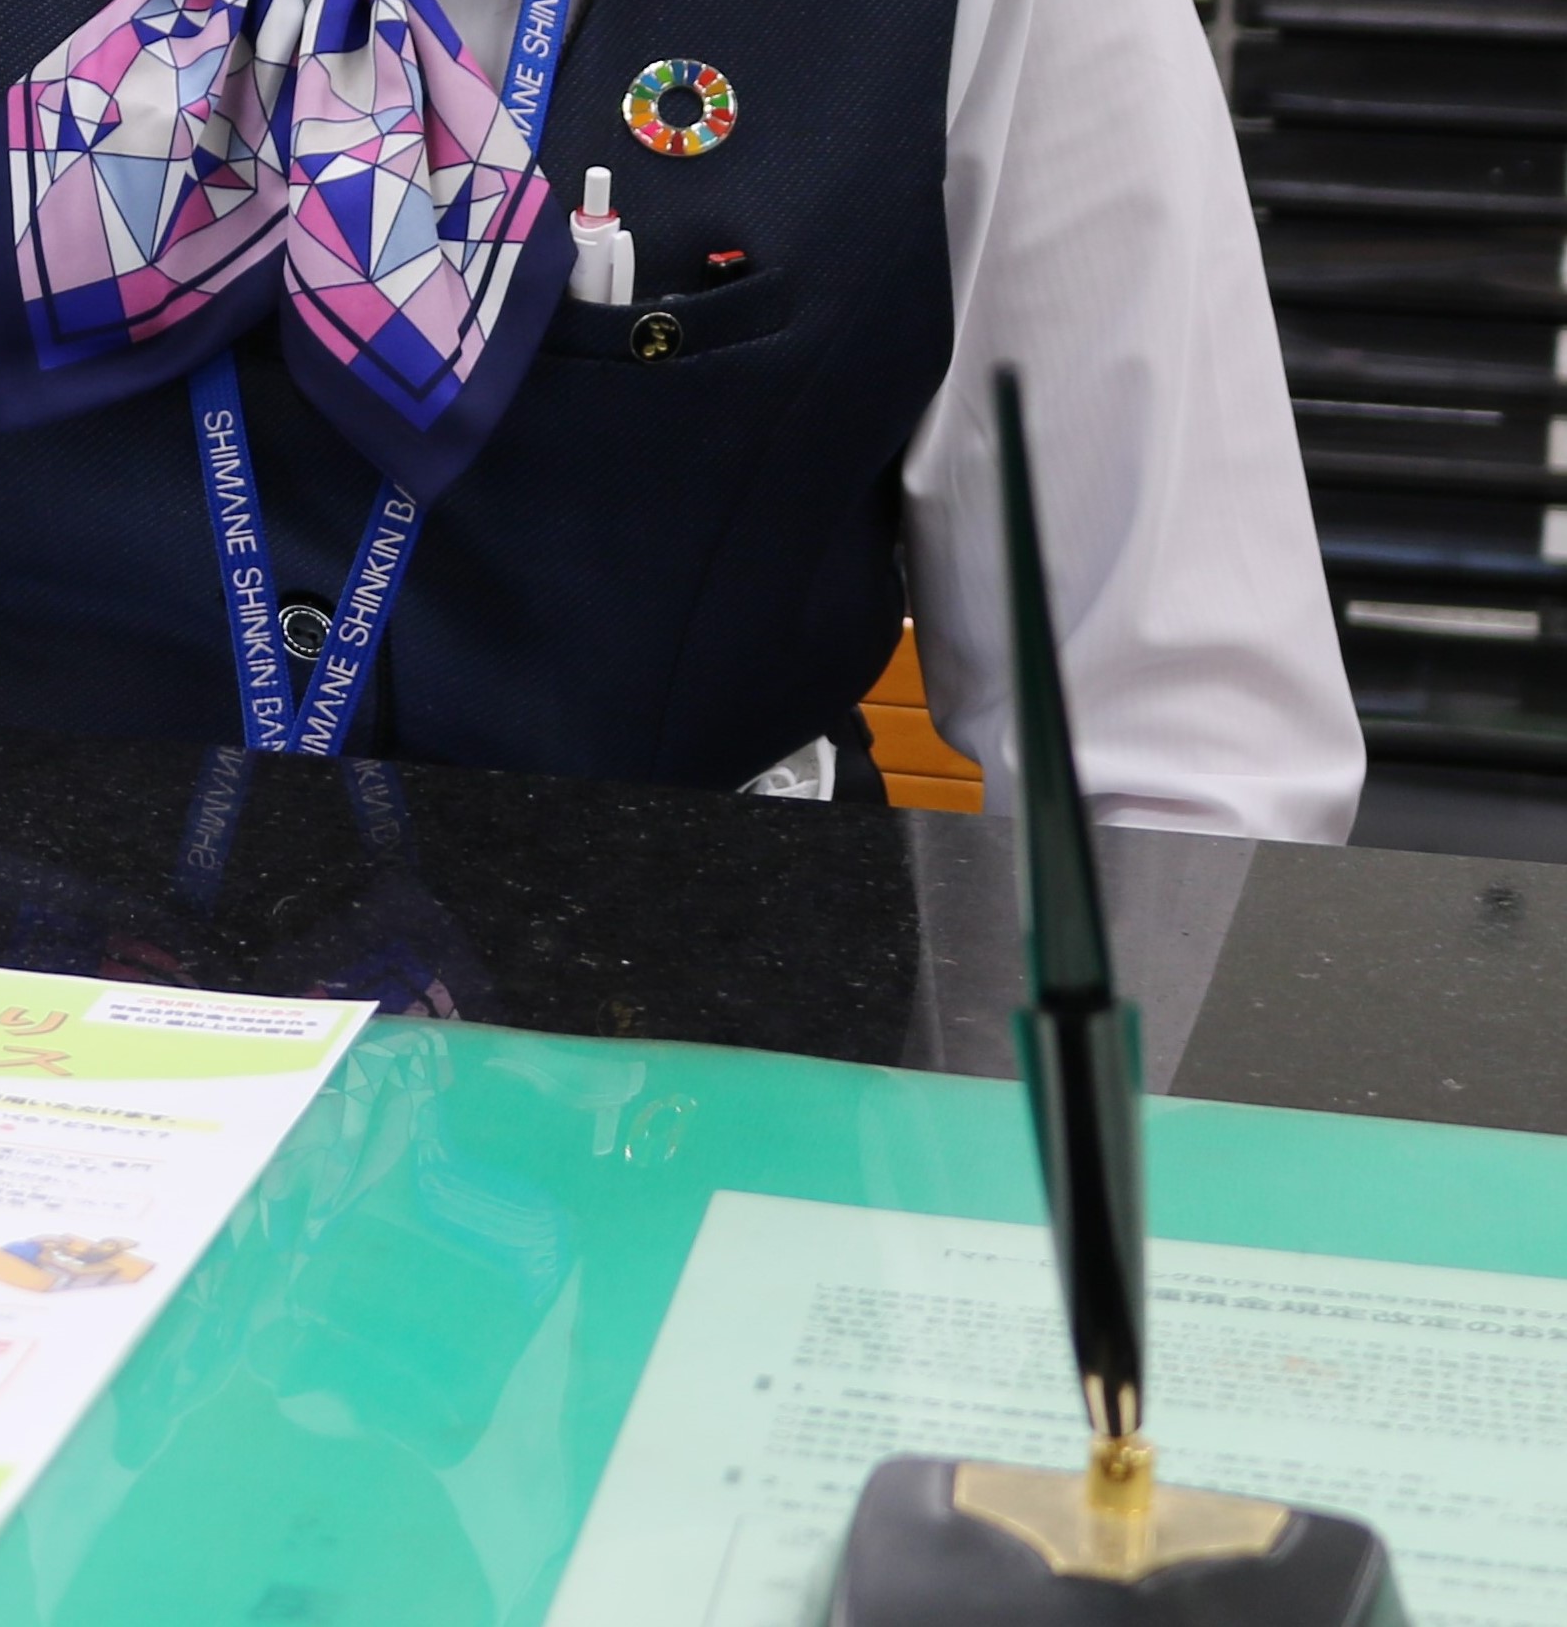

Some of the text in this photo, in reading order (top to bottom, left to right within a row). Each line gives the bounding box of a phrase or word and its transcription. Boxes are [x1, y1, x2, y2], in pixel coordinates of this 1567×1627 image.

[203, 409, 258, 556] SHIMANE
[232, 566, 280, 689] SHINKIN
[338, 526, 407, 648] SHINKIN
